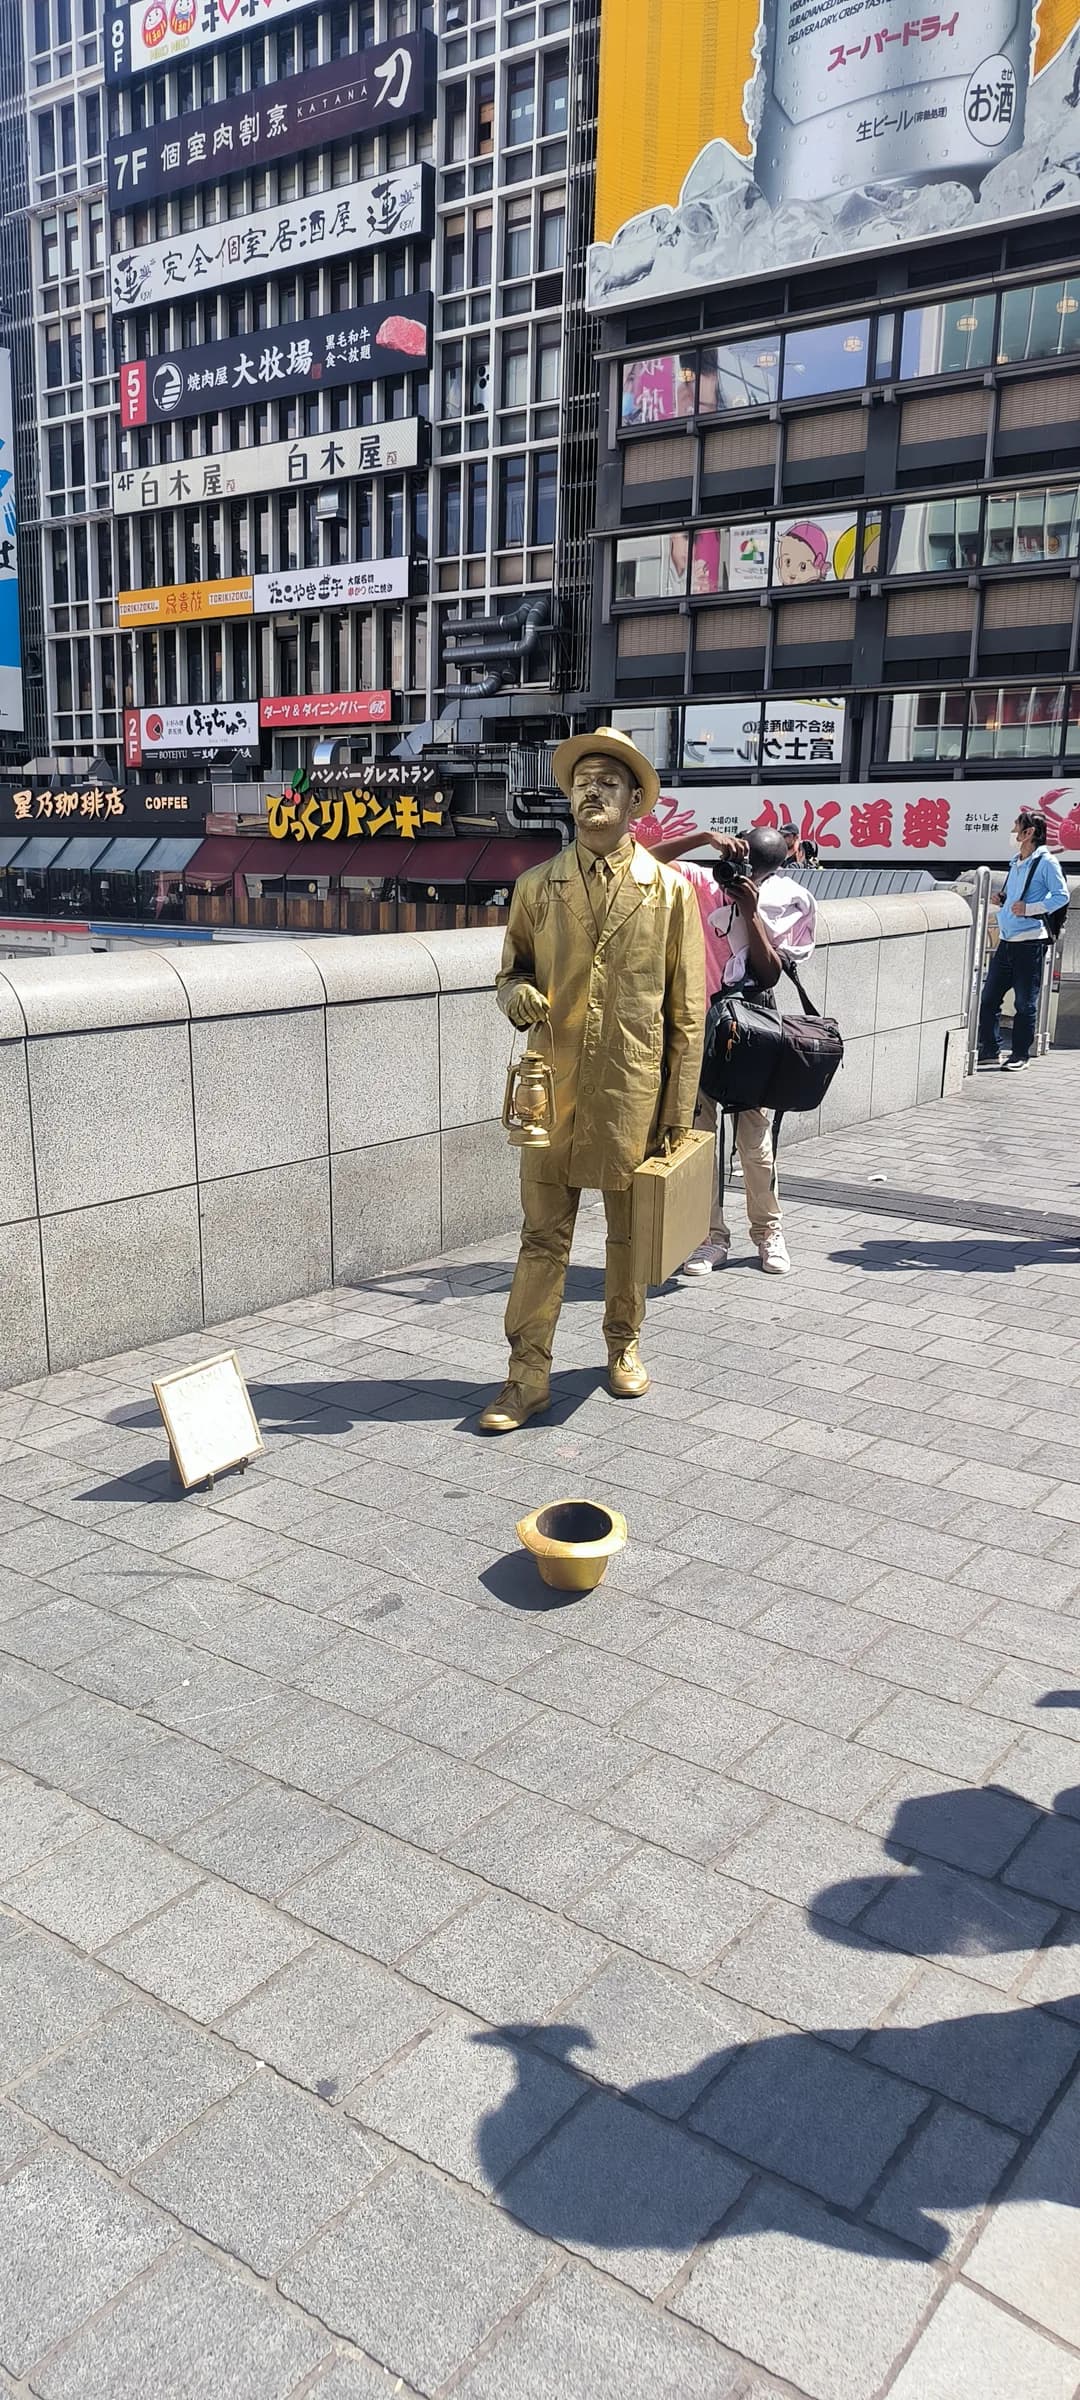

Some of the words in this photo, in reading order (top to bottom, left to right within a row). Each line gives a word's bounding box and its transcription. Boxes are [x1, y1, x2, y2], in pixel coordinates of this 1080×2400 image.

[838, 2, 865, 20] CRISP
[827, 12, 960, 72] スーパードライ
[374, 47, 412, 108] 刀
[296, 86, 368, 117] KATANA
[968, 82, 1014, 123] お酒
[160, 103, 289, 172] 個室肉割烹
[114, 148, 148, 191] 7F
[162, 201, 357, 285] 完全個室居酒屋
[325, 328, 371, 350] 黒毛和牛
[186, 366, 229, 392] 焼肉屋
[231, 338, 315, 388] 大牧場
[325, 346, 372, 369] 食べ放題
[288, 434, 383, 482] 白木屋
[117, 474, 135, 492] 4F
[141, 463, 223, 507] 白木屋
[264, 704, 290, 719] ダーツ
[302, 701, 367, 717] ダイニングバー
[310, 765, 435, 784] ハンバーグレストラン
[13, 787, 126, 821] 星乃珈琲店
[145, 796, 188, 810] COFFEE
[265, 788, 444, 842] びっくりドンキー
[965, 813, 999, 822] おいしさ
[964, 823, 999, 832] 年中無休
